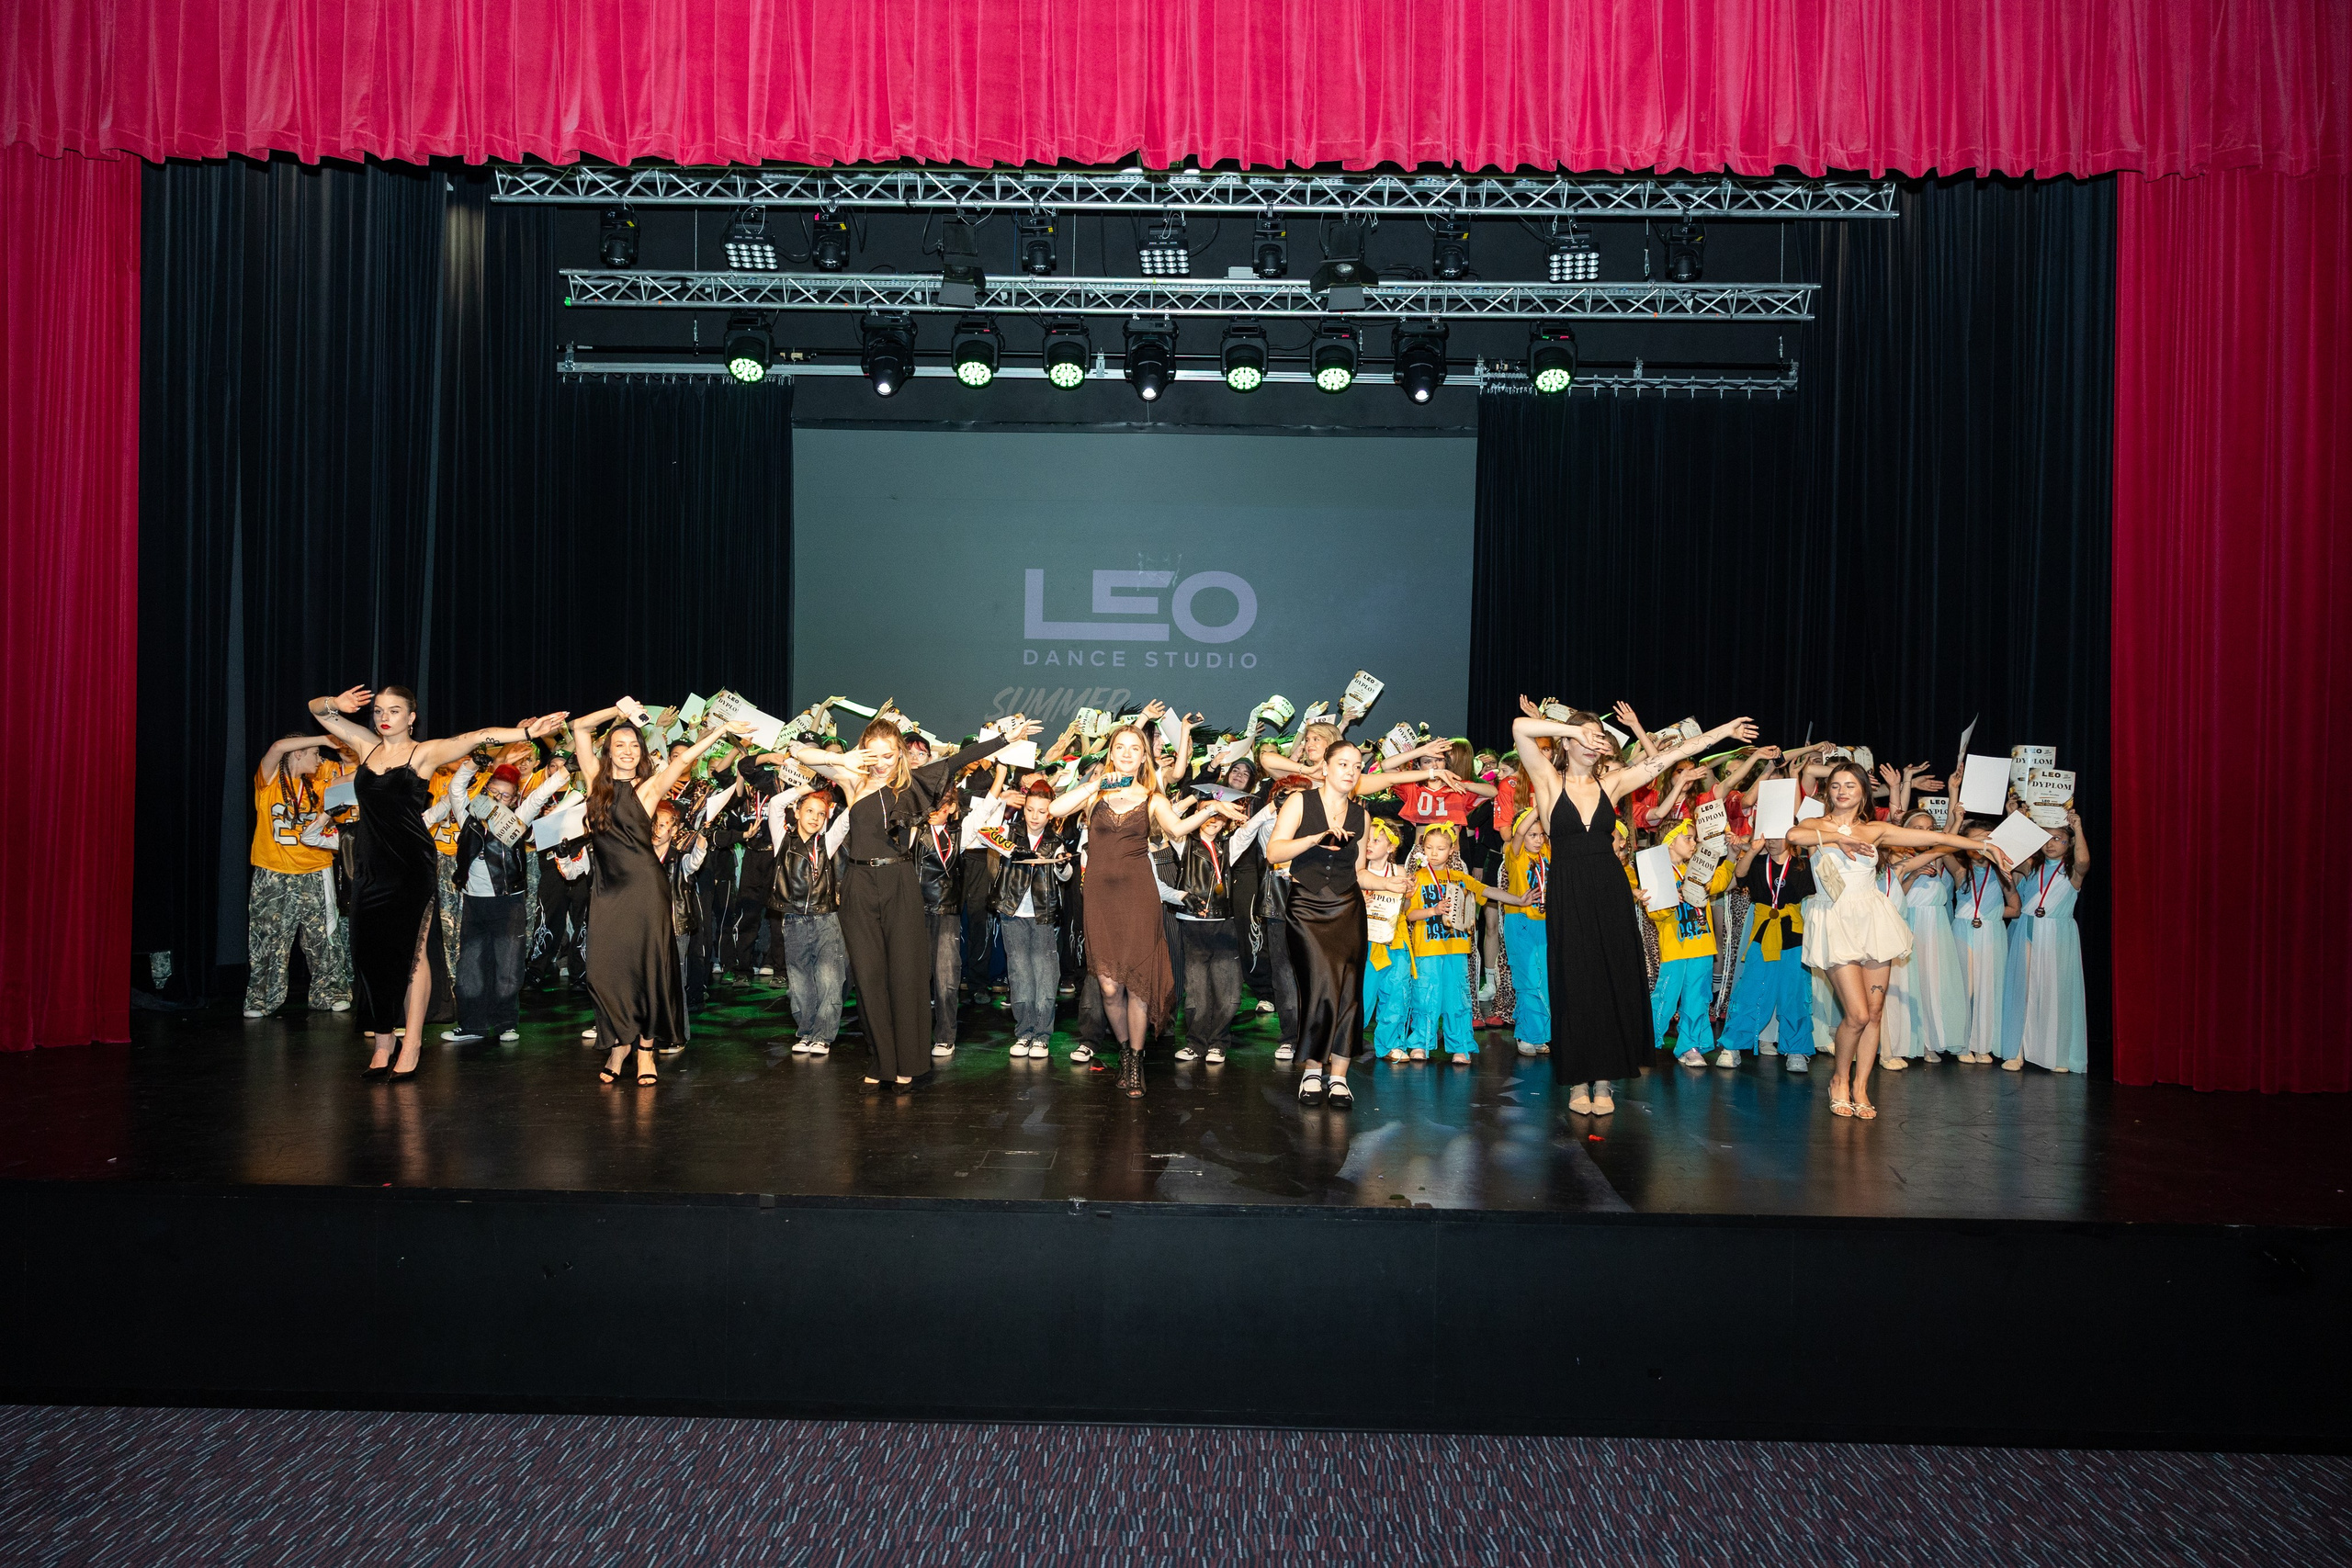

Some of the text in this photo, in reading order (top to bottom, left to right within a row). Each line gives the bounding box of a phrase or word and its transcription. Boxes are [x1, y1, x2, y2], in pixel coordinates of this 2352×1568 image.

[1023, 569, 1258, 643] LEO
[1023, 649, 1258, 669] DANCE STUDIO
[1363, 674, 1375, 684] LEO
[727, 694, 740, 705] LEO
[984, 686, 1131, 723] SUMMER
[1407, 728, 1416, 740] LEO
[2041, 771, 2062, 779] LEO
[787, 776, 803, 787] LEO
[2031, 781, 2072, 791] DYPLOM
[1417, 792, 1448, 817] 01
[1701, 804, 1714, 813] LEO
[1697, 810, 1725, 825] DYPLOM
[496, 816, 517, 840] DYPLOM
[508, 828, 522, 841] LEO
[1700, 847, 1713, 857] LEO
[1691, 854, 1715, 872] DYPLOM
